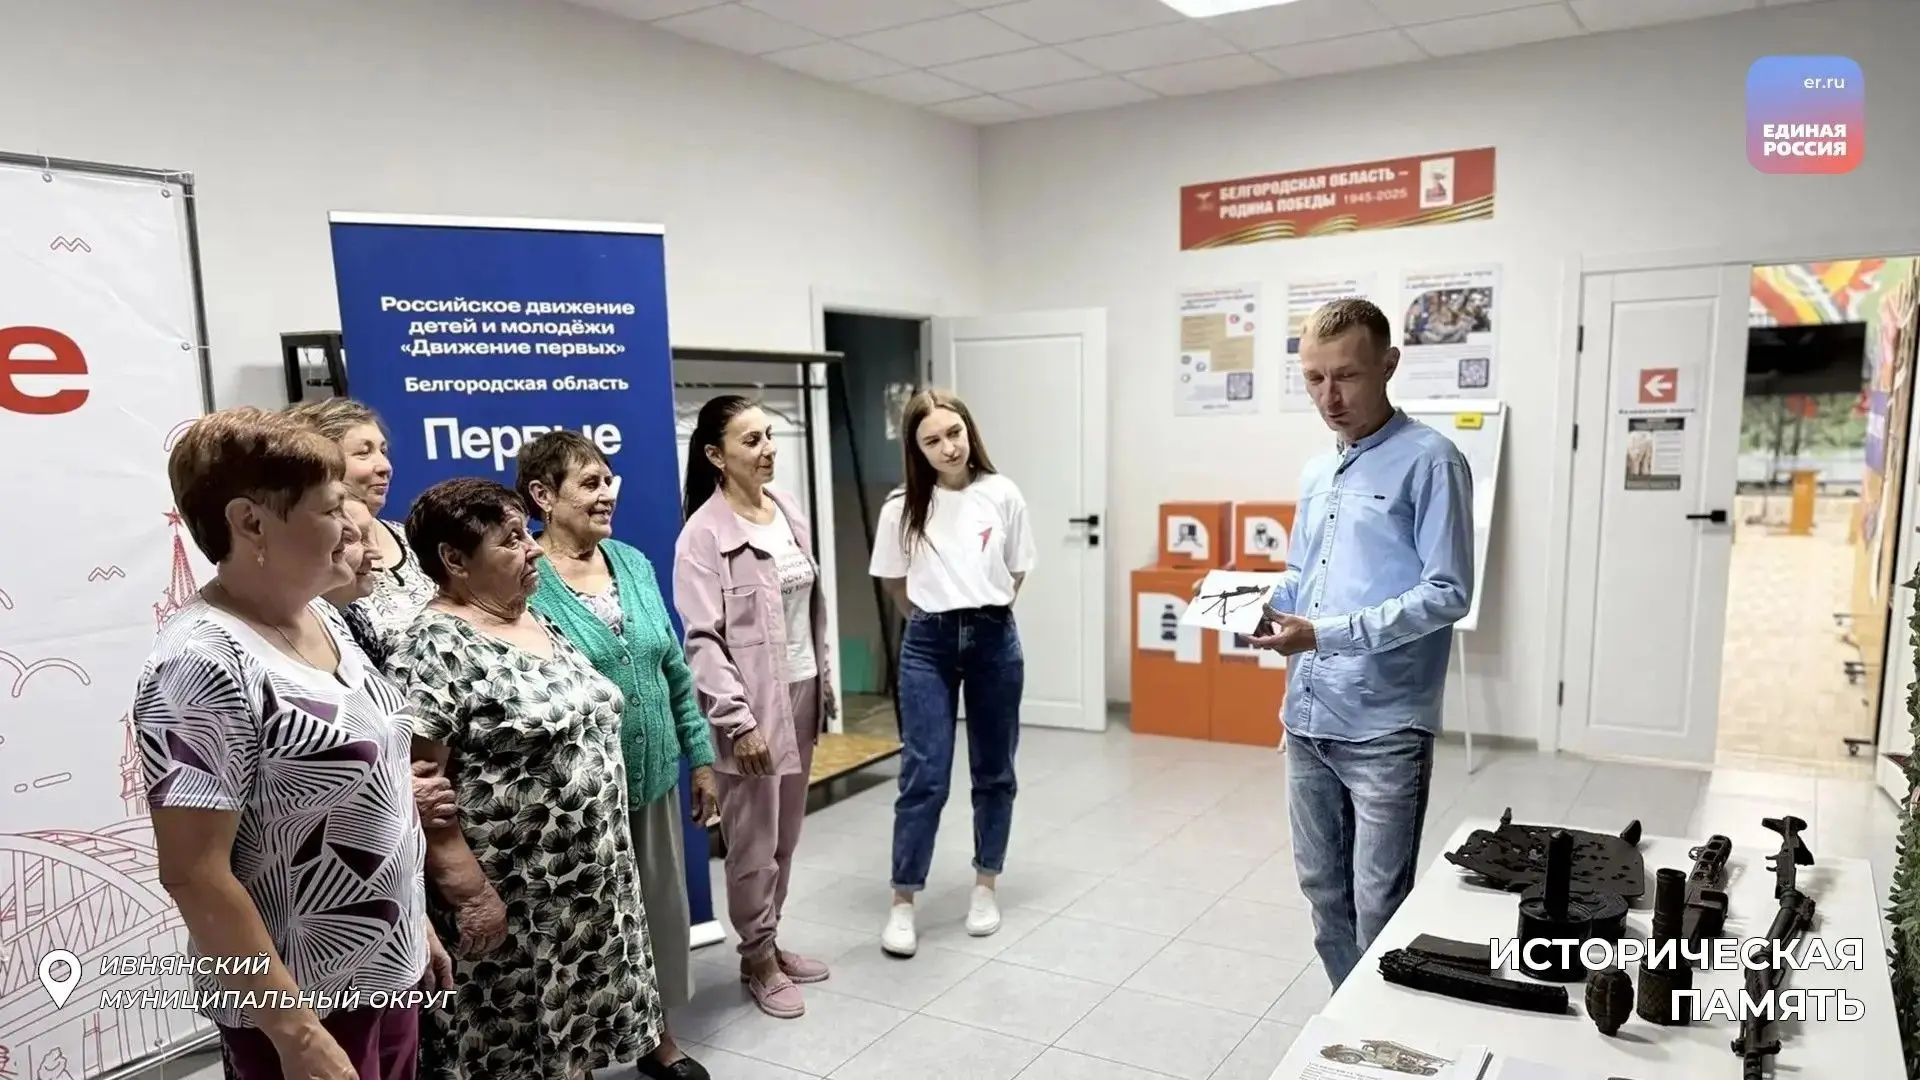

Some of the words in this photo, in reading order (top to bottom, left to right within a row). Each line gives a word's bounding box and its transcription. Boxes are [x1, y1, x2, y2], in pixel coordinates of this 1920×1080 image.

[1219, 175, 1327, 201] БЕЛГОРОДСКАЯ
[1329, 167, 1396, 188] ОБЛАСТЬ
[1219, 200, 1274, 219] РОДИНА
[1276, 192, 1337, 213] ПОБЕДЫ
[1343, 187, 1408, 205] 1945-2025
[380, 296, 521, 314] Российское
[525, 301, 636, 316] движение
[408, 318, 477, 336] детей
[482, 322, 497, 334] и
[500, 319, 616, 337] молодёжи
[400, 338, 532, 357] «Движение
[534, 342, 626, 358] первых»
[404, 376, 548, 395] Белгородская
[551, 375, 630, 391] область
